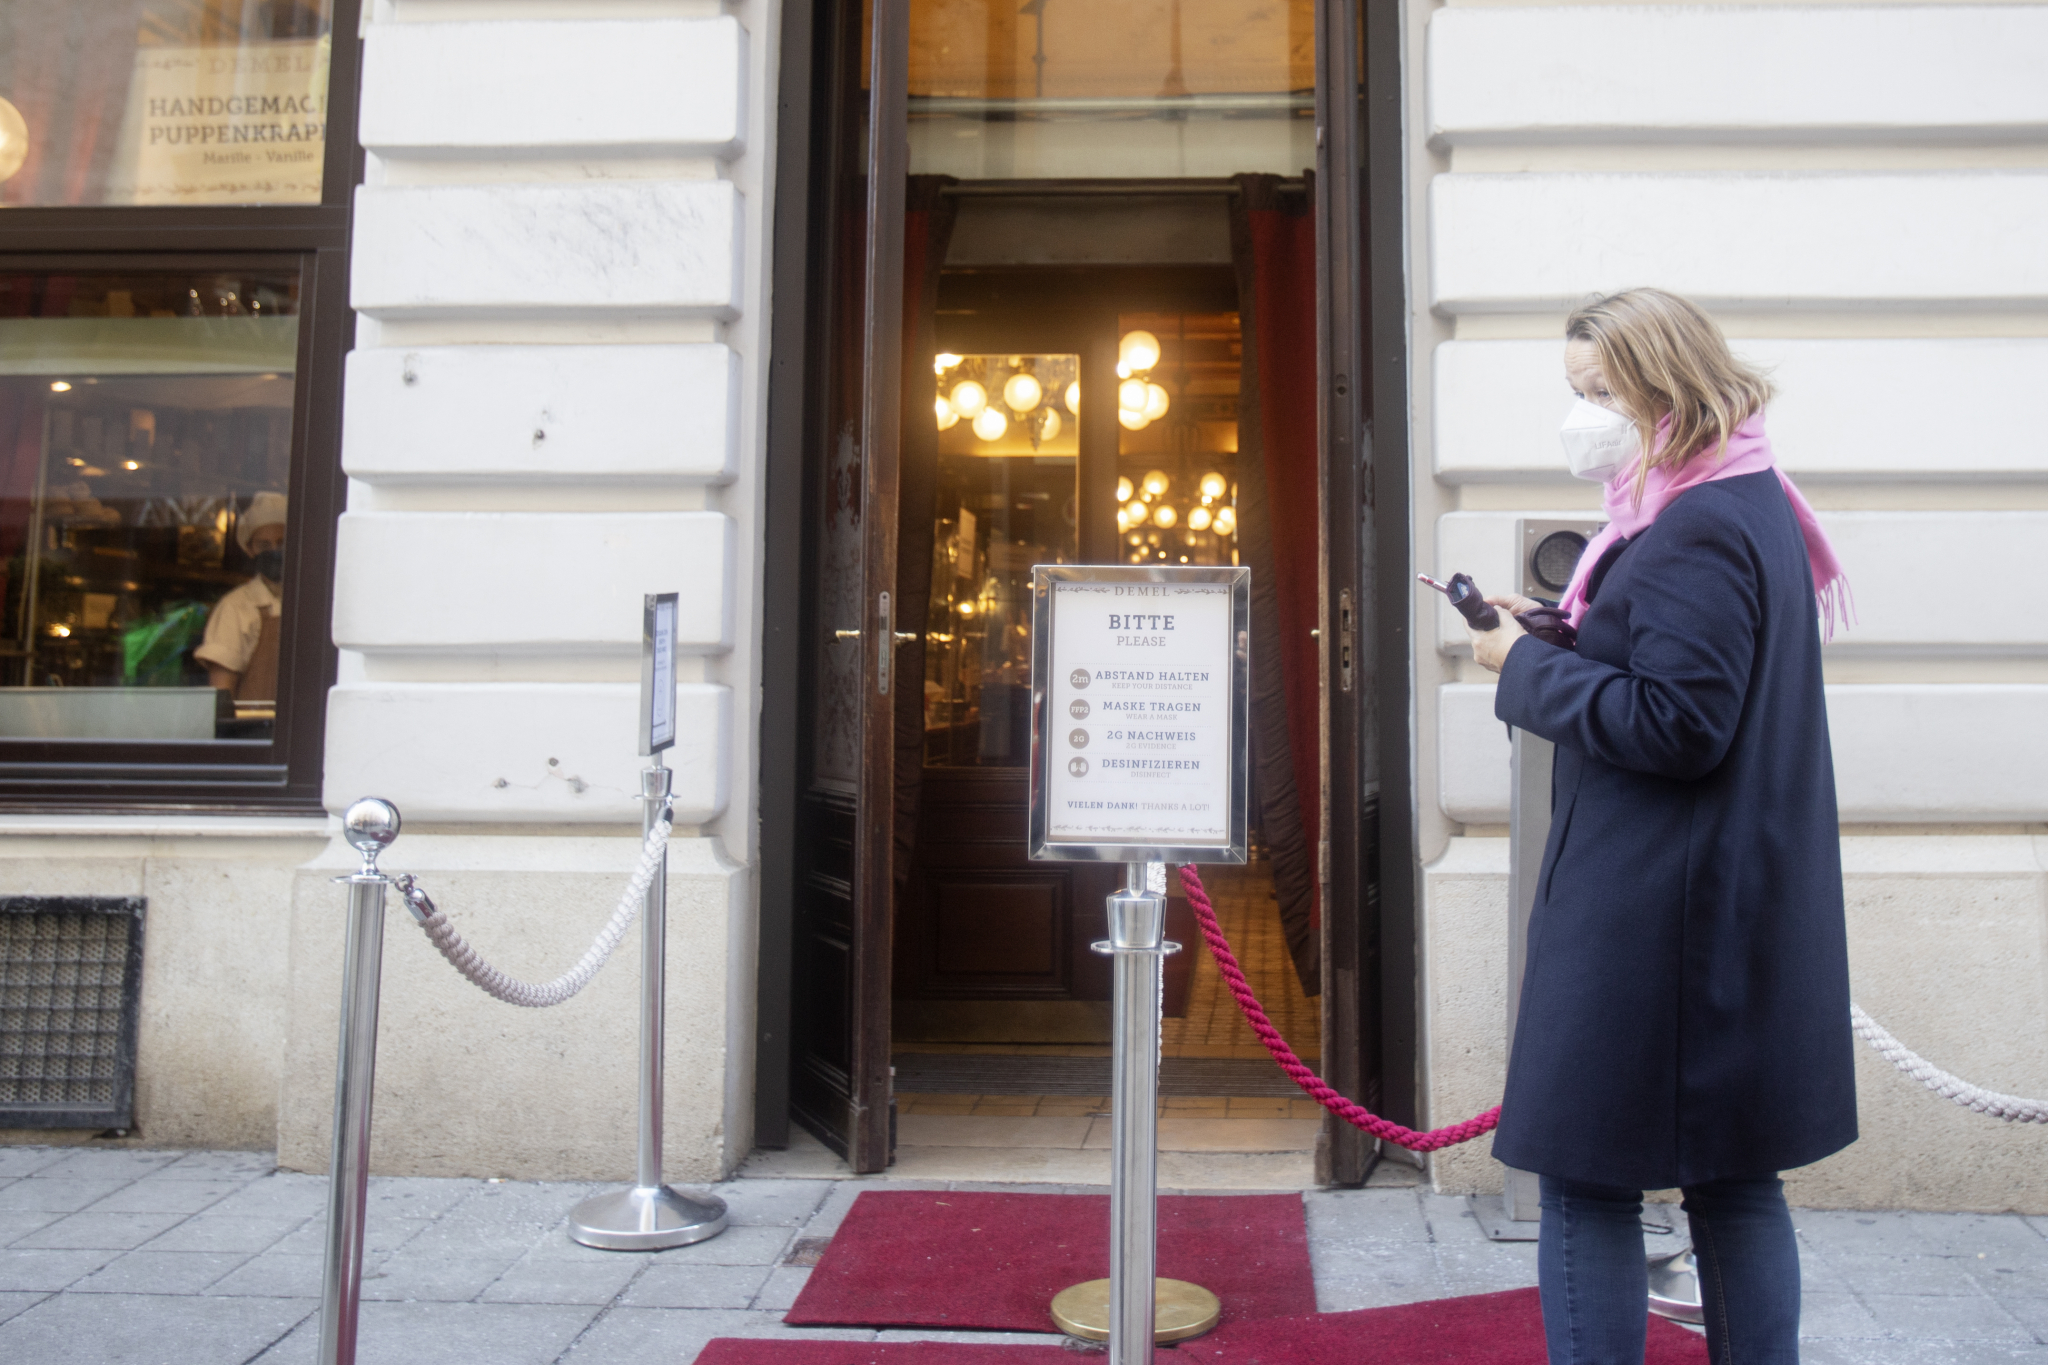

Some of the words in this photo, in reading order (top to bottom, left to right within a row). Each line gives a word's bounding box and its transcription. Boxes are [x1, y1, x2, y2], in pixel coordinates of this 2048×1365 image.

[150, 95, 326, 117] HANDGEMAC
[203, 150, 252, 165] Marille
[266, 150, 315, 163] Vanille
[1114, 586, 1171, 597] DEMEL
[1108, 614, 1175, 631] BITTE
[1116, 635, 1167, 647] PLEASE
[1071, 674, 1089, 684] 2m
[1095, 670, 1155, 681] ABSTAND
[1159, 671, 1210, 682] HALTEN
[1112, 682, 1131, 690] KEEP
[1132, 682, 1154, 690] YOUR
[1155, 683, 1193, 691] DISTANCE
[1071, 706, 1089, 714] FFP2
[1103, 701, 1146, 711] MASKE
[1150, 702, 1201, 712] TRAGEN
[1156, 713, 1178, 721] MASK
[1073, 735, 1085, 743] 2G
[1107, 730, 1123, 740] 2G
[1127, 731, 1196, 741] NACHWEIS
[1138, 742, 1177, 750] EVIDENCE
[1102, 758, 1200, 770] DESINFIZIEREN
[1130, 771, 1172, 779] DISINFECT
[1067, 800, 1104, 809] VIELEN
[1107, 801, 1138, 810] DANK!
[1141, 802, 1179, 811] THANKS
[1181, 803, 1188, 811] A
[1189, 803, 1210, 811] LOT!
